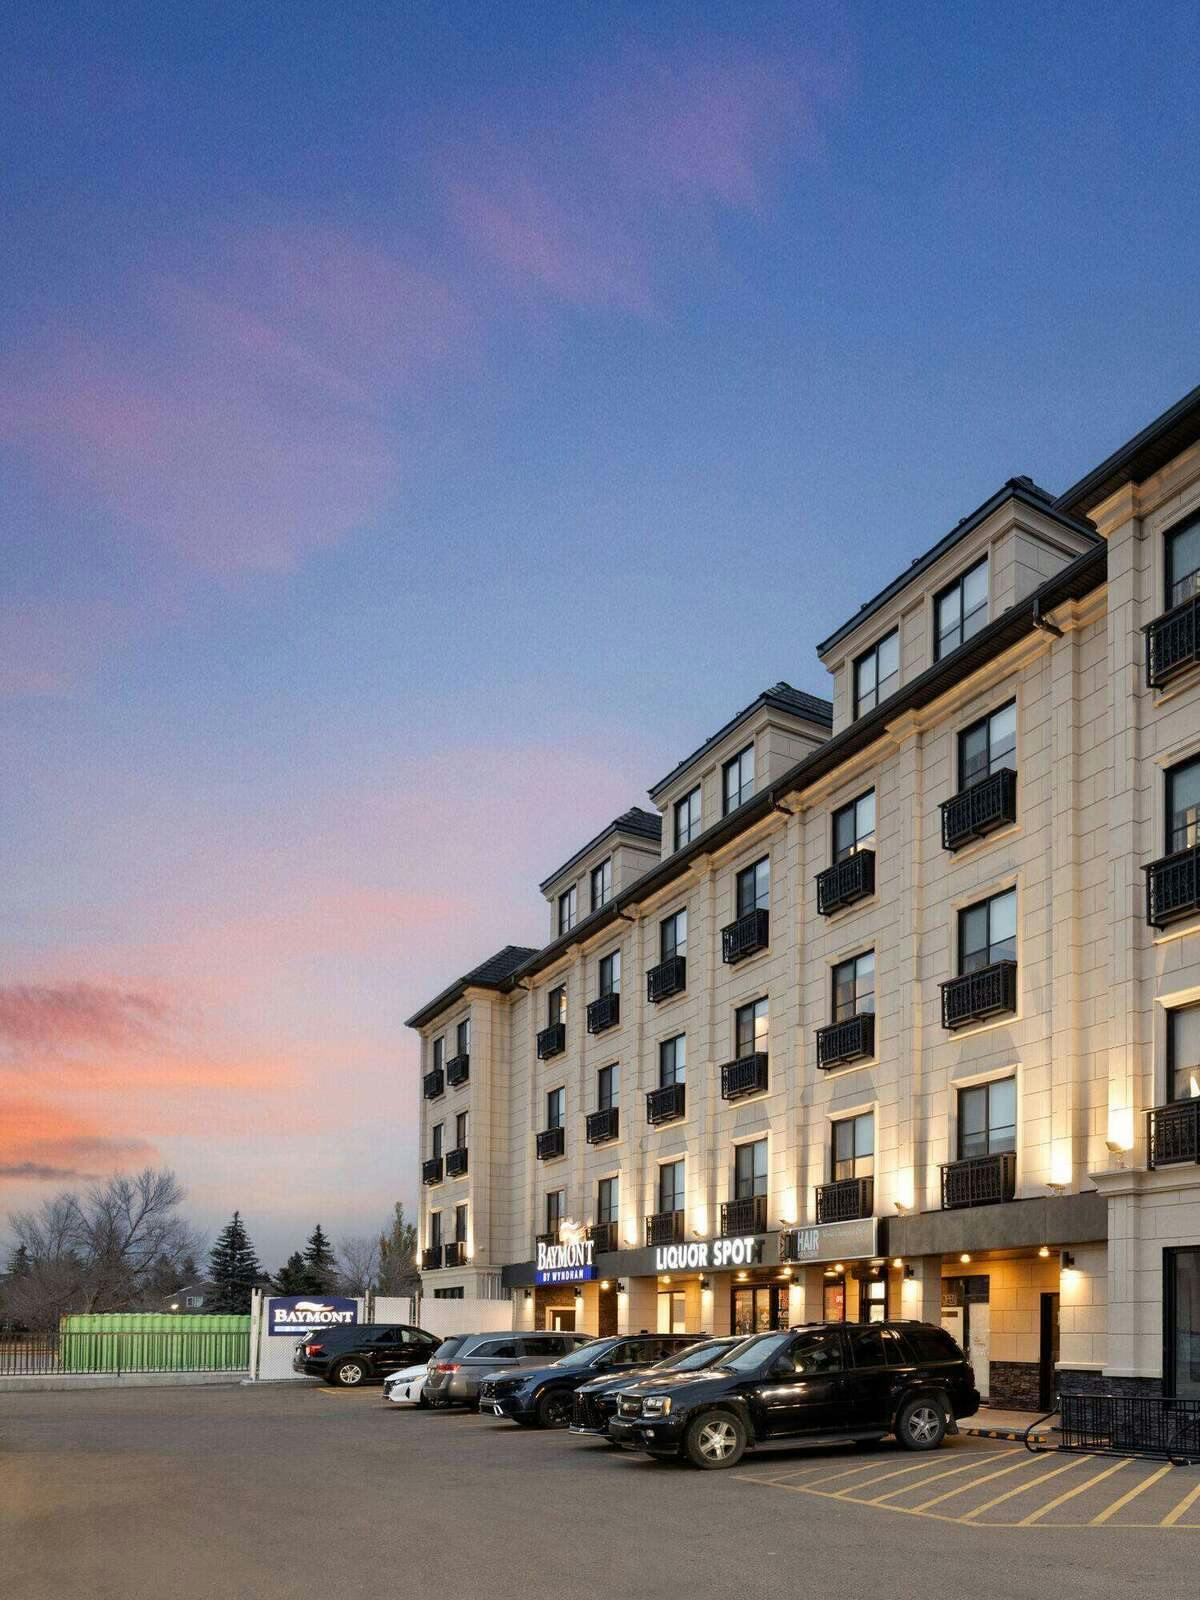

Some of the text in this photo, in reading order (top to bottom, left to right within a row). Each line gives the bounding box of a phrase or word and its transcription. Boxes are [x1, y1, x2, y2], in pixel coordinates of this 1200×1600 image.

[797, 1229, 819, 1251] HAIR
[537, 1240, 594, 1270] BAYMONT
[656, 1242, 708, 1270] LIQUOR
[713, 1238, 754, 1266] SPOT
[543, 1269, 584, 1282] BY WYNDHAM
[274, 1309, 353, 1322] BAYMONT
